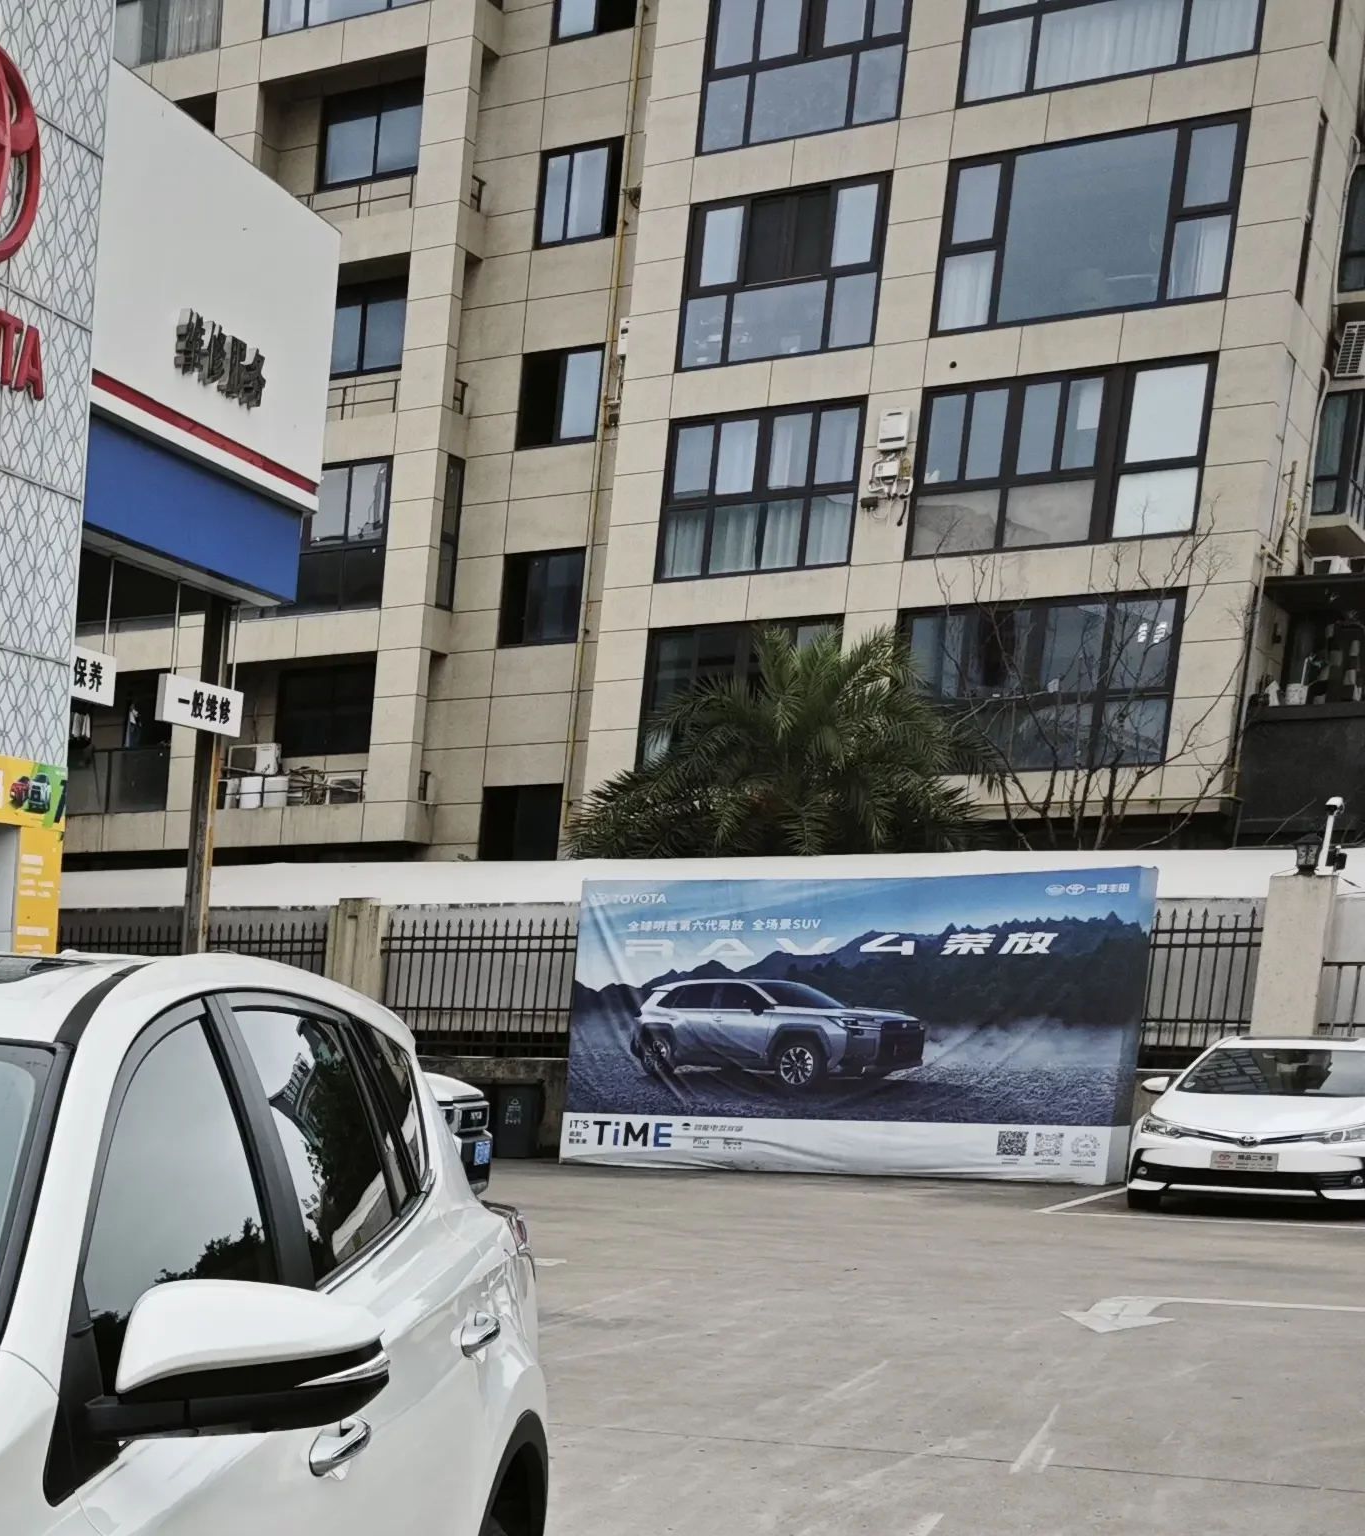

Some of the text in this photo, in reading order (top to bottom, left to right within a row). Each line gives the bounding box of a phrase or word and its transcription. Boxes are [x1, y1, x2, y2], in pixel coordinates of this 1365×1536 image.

[73, 656, 103, 693] 保养
[177, 689, 232, 724] 一般维修
[611, 892, 667, 905] TOYOTA
[624, 931, 1059, 958] RAV4 荣放
